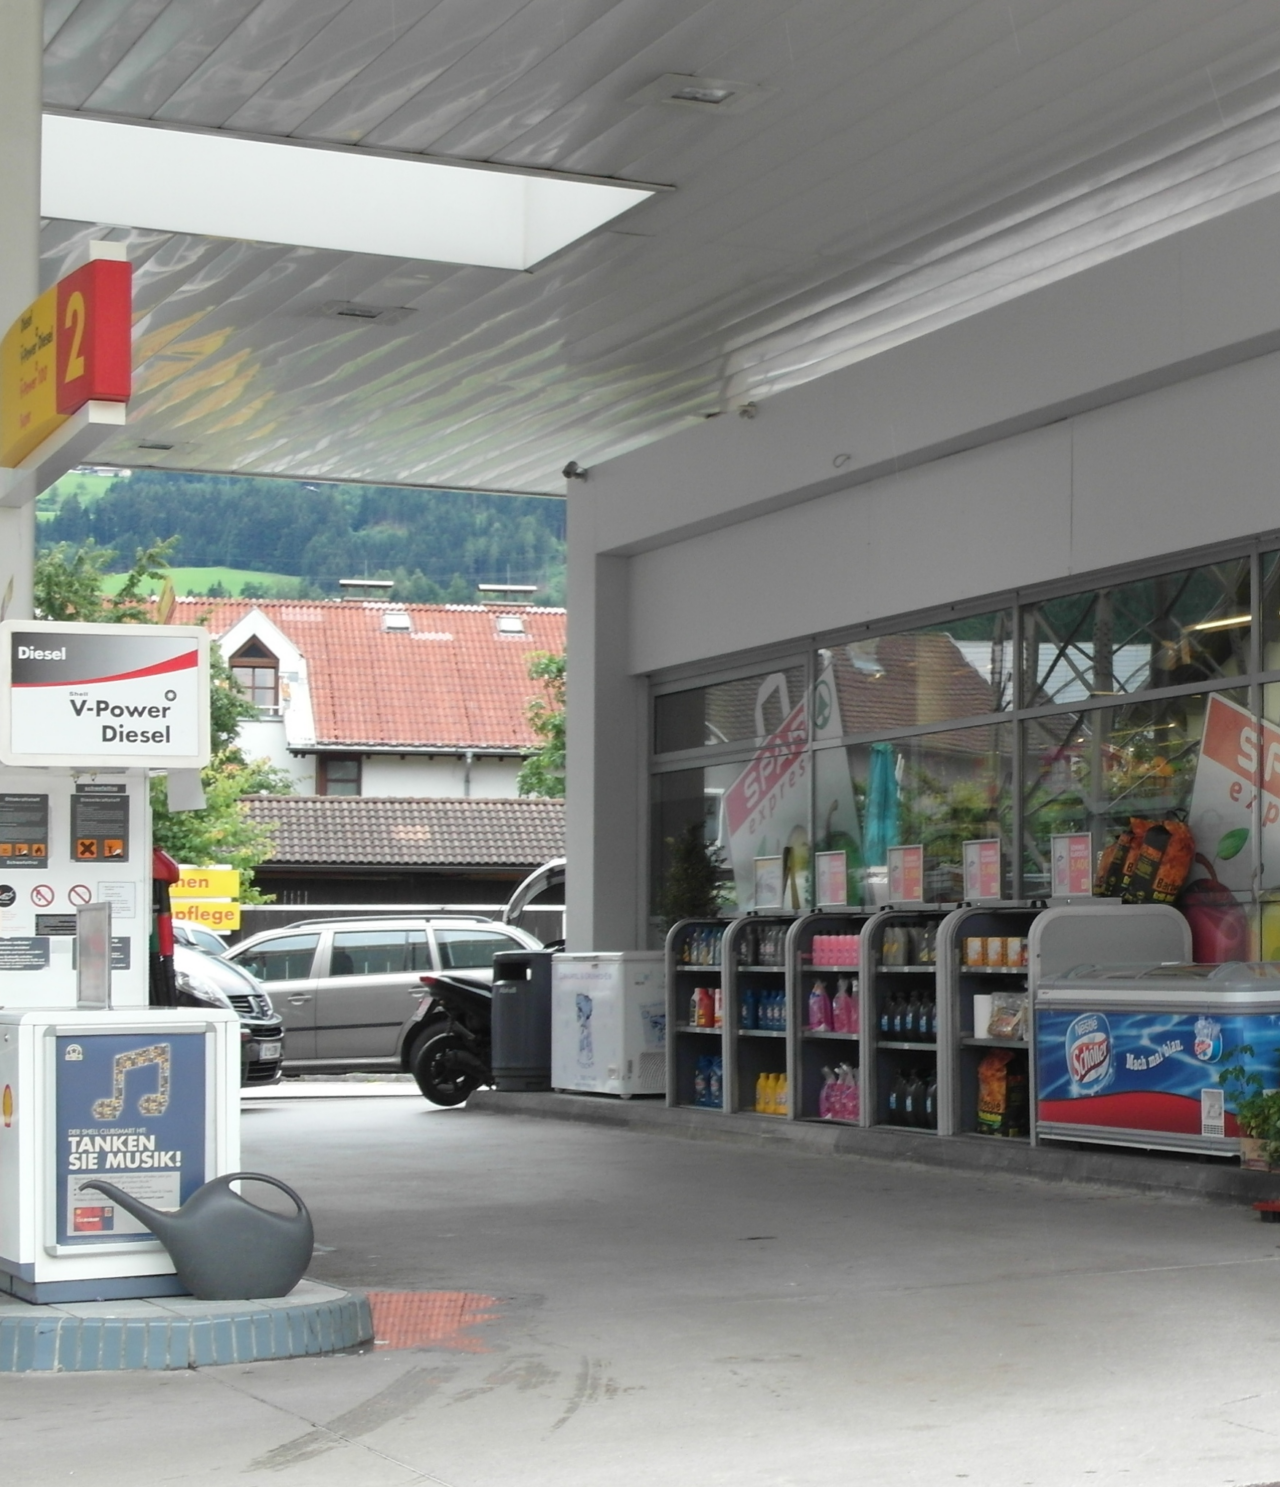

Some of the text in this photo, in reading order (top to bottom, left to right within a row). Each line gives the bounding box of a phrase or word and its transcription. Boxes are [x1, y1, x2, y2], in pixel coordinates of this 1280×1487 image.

[65, 291, 84, 384] 2
[18, 646, 66, 661] Diesel
[70, 699, 171, 718] V-Power
[102, 724, 171, 744] Diesel
[1075, 1016, 1099, 1036] Nestlé
[1072, 1041, 1108, 1081] Schöller
[1126, 1040, 1184, 1071] Mach mal blau.
[68, 1135, 155, 1152] TANKEN
[68, 1151, 182, 1170] SIE MUSIK!
